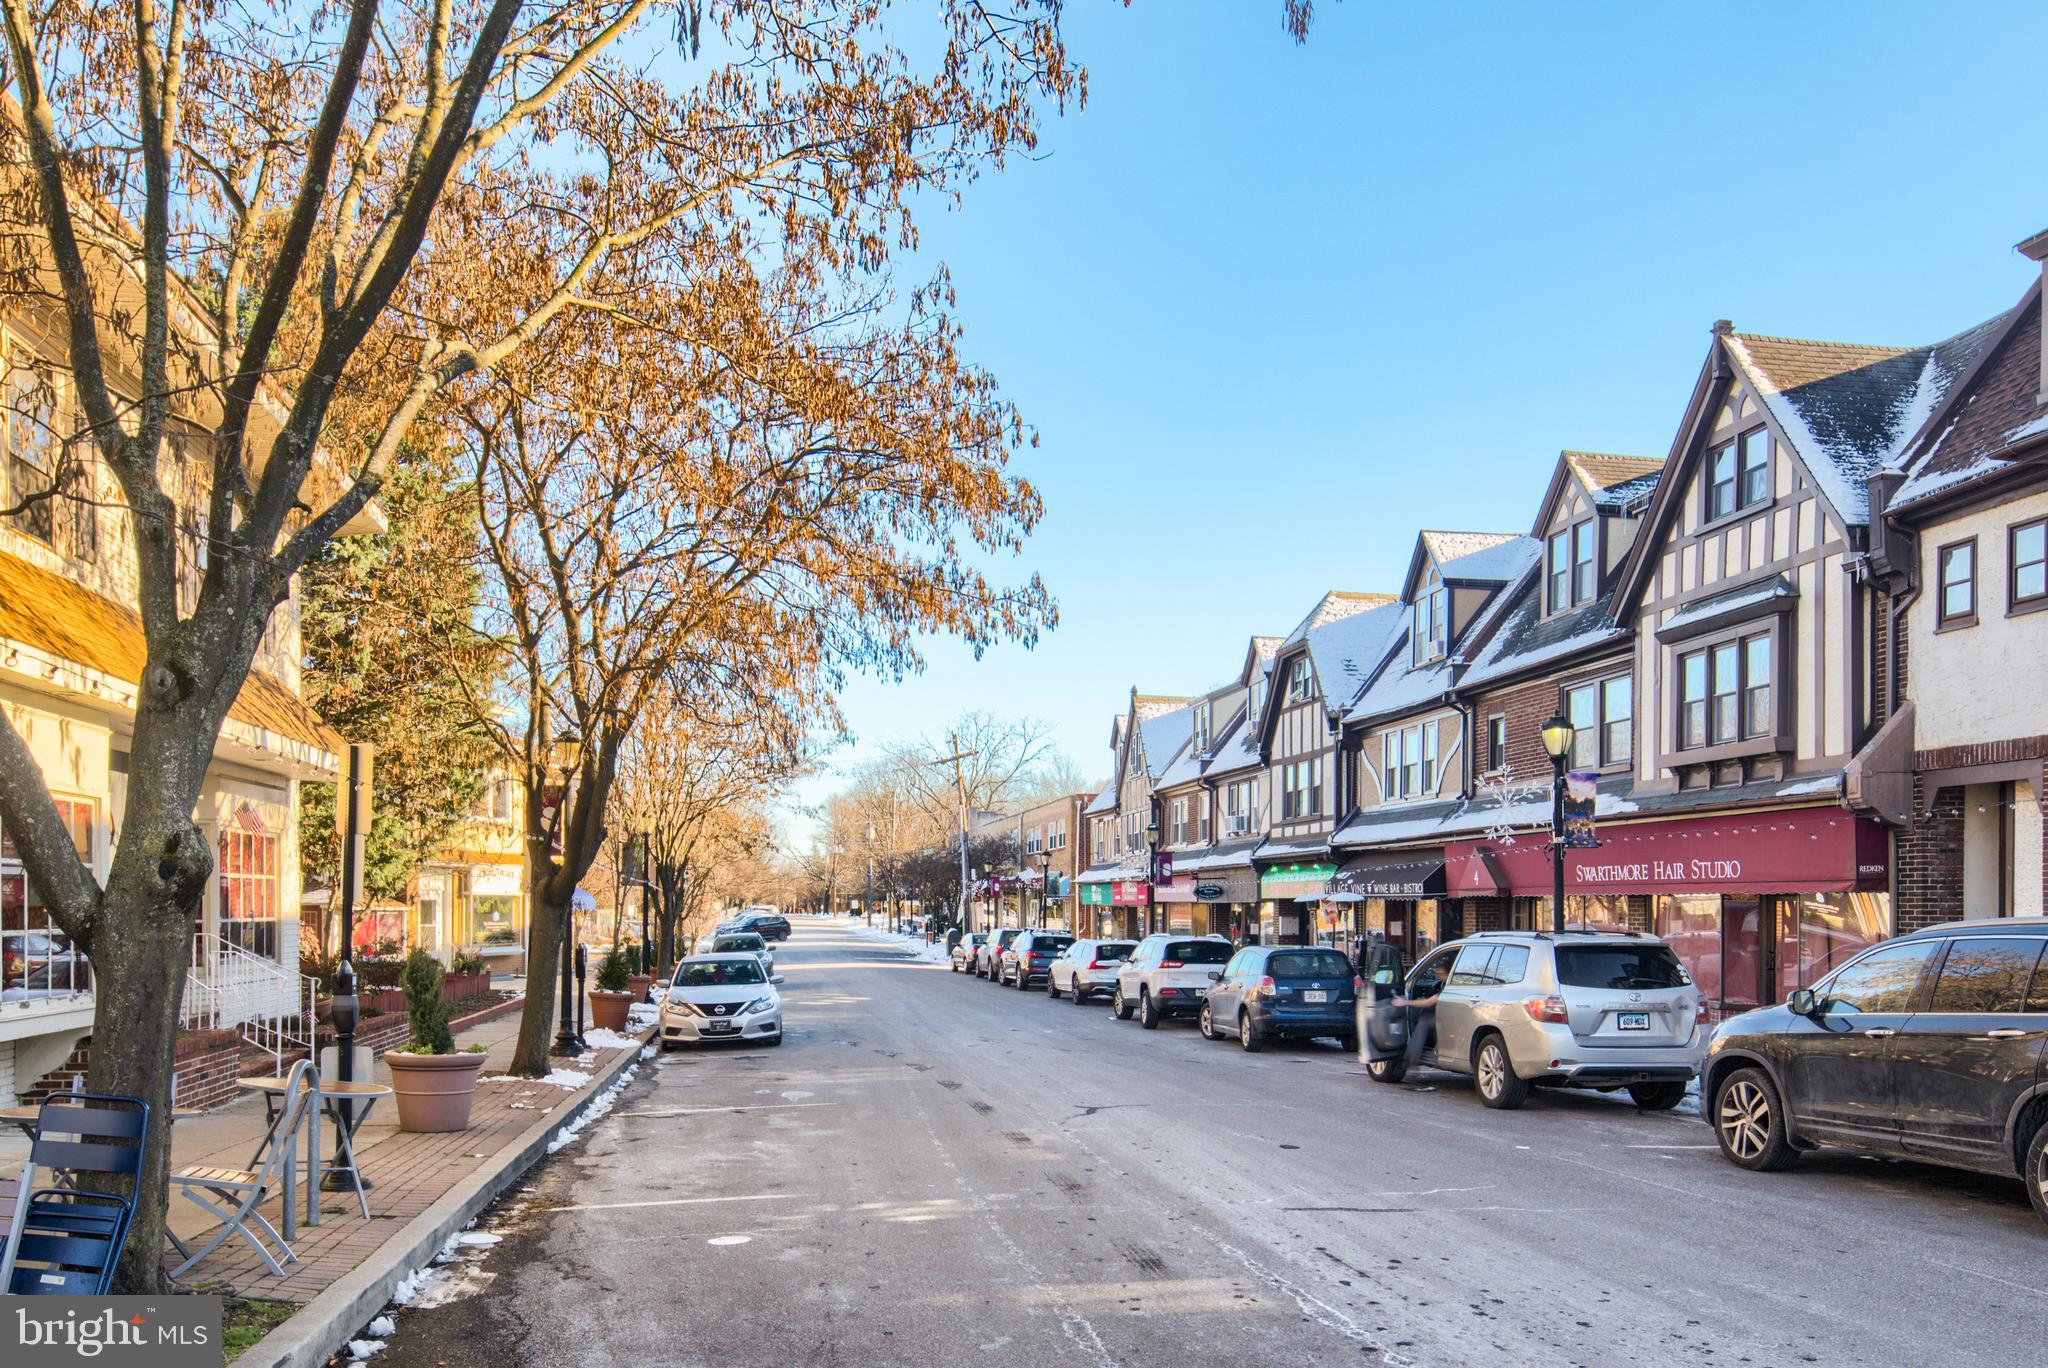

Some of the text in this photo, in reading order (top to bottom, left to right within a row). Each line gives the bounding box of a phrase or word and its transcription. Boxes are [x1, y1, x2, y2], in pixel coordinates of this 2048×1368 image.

[1473, 869, 1479, 886] 4
[1576, 859, 1741, 882] SWARTHMORE HAIR STUDIO
[1325, 883, 1348, 894] VILLAGE
[1351, 883, 1365, 894] VINE
[1373, 883, 1388, 894] WINE
[1390, 883, 1400, 894] BAR
[1403, 882, 1423, 894] BISTRO
